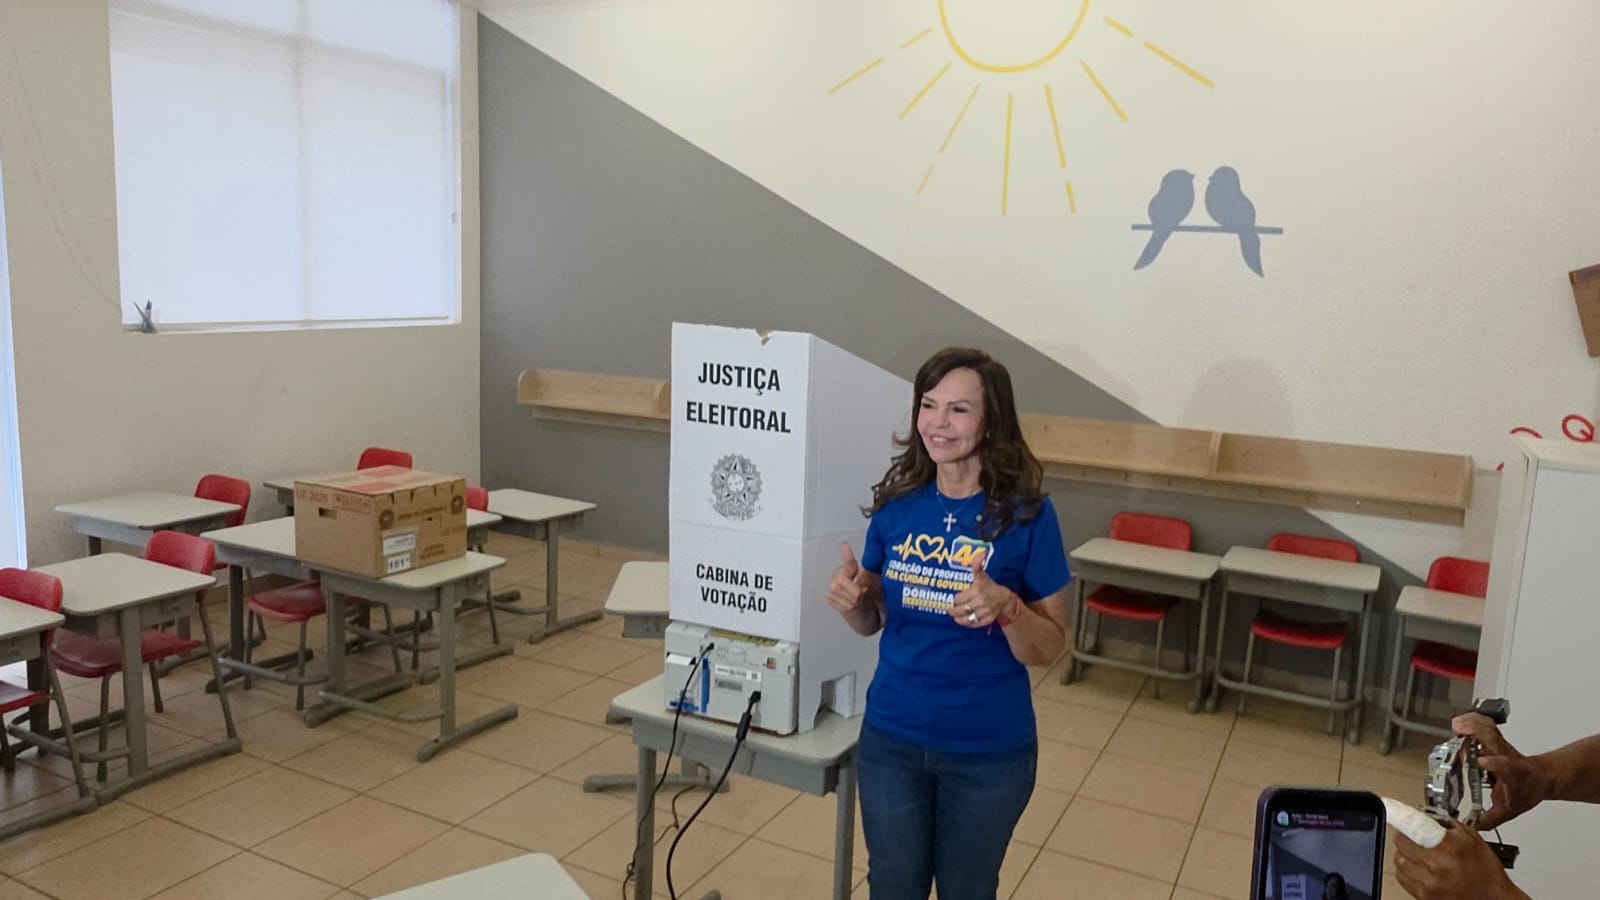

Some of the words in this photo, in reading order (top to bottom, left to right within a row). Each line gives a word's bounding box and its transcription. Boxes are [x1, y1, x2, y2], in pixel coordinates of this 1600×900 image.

[698, 362, 781, 396] JUSTIÇA
[686, 401, 791, 433] ELEITORAL
[696, 563, 749, 588] CABINA
[754, 574, 773, 591] DE
[899, 572, 930, 586] CUIDAR
[930, 578, 936, 587] E
[939, 579, 972, 592] GOVERN
[922, 566, 933, 577] DE
[934, 568, 975, 583] PROFESSO
[700, 586, 767, 614] VOTAÇÃO
[902, 587, 954, 604] DORINHA
